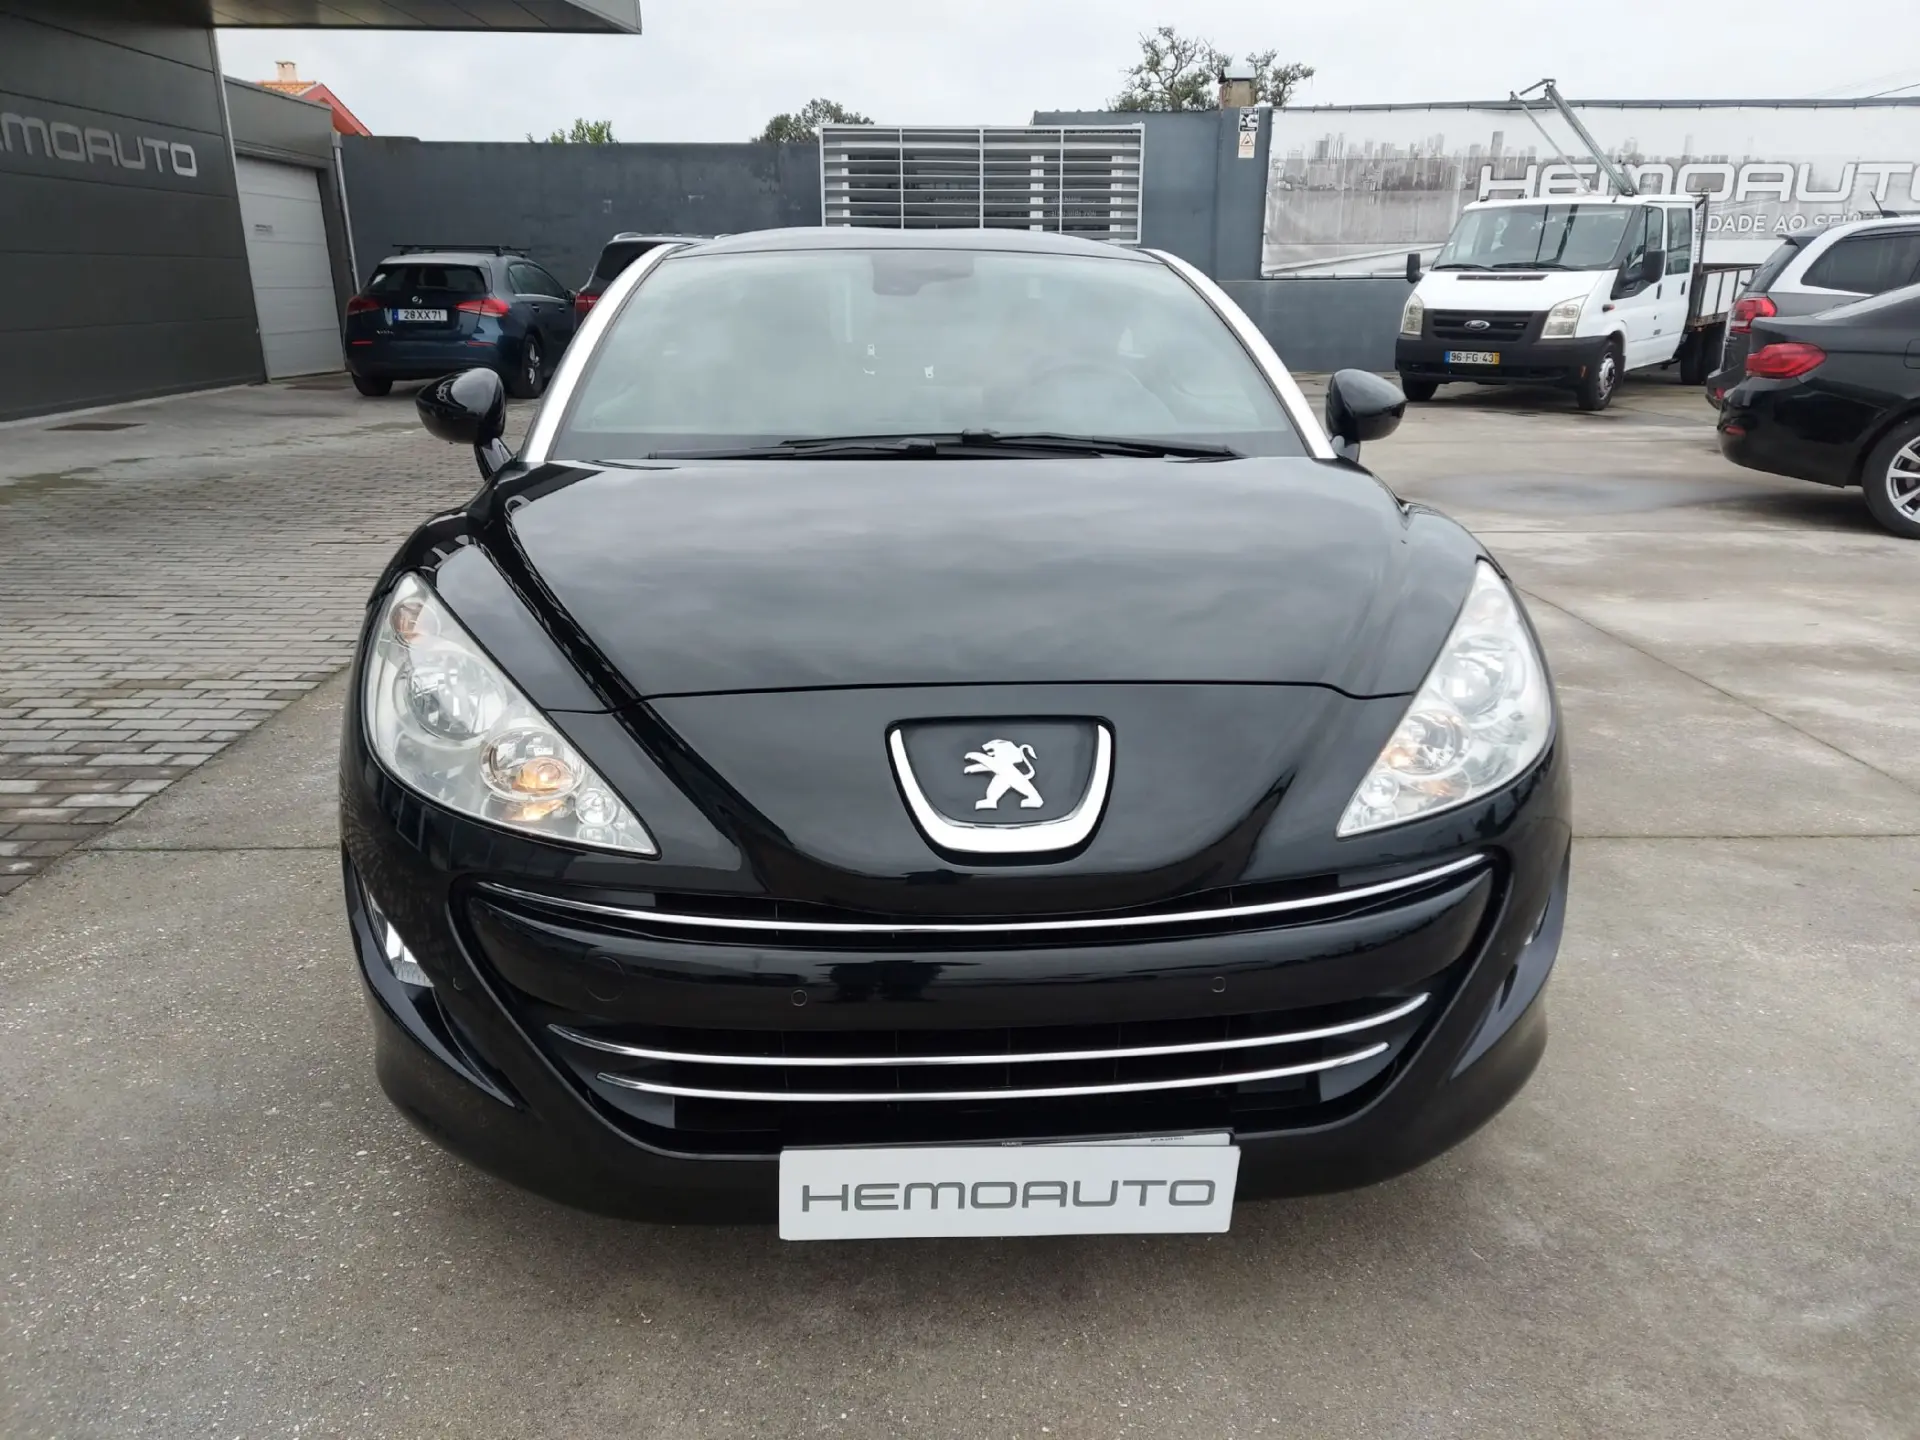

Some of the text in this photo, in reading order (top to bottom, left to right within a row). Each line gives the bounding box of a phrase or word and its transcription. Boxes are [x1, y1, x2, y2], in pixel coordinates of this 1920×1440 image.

[0, 112, 197, 177] MOAUTO
[1480, 163, 1920, 201] HEMOAUT
[1706, 215, 1767, 232] DADE
[1772, 214, 1806, 232] AO
[801, 1179, 1217, 1213] HEMOAUTO
